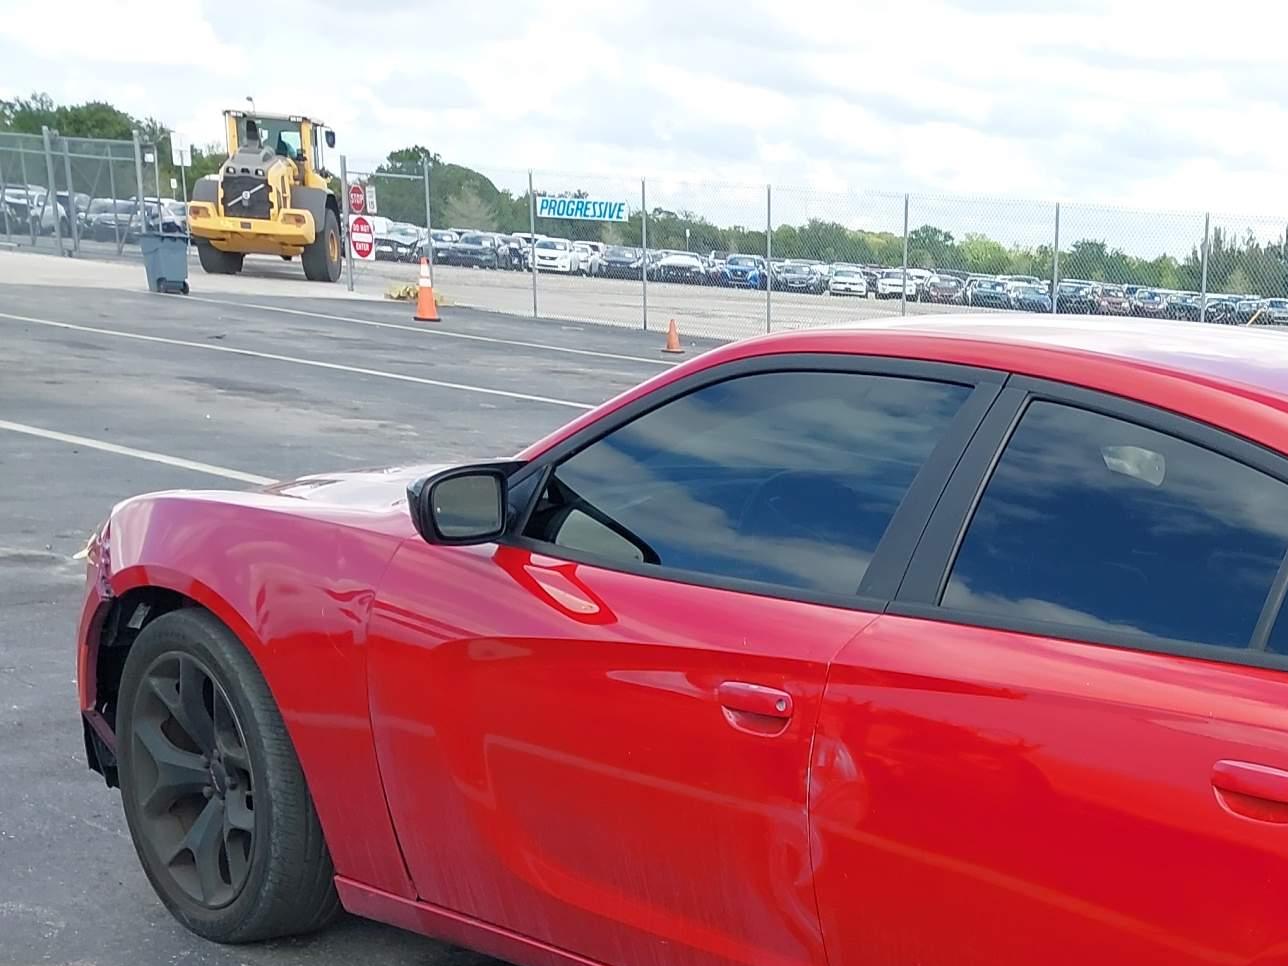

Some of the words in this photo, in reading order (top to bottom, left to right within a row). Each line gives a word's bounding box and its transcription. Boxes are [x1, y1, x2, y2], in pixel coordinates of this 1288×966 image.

[350, 193, 363, 204] STOP
[540, 199, 625, 219] PROGRESSIVE
[353, 223, 359, 232] DO
[360, 224, 370, 233] NOT
[355, 242, 370, 252] ENTER
